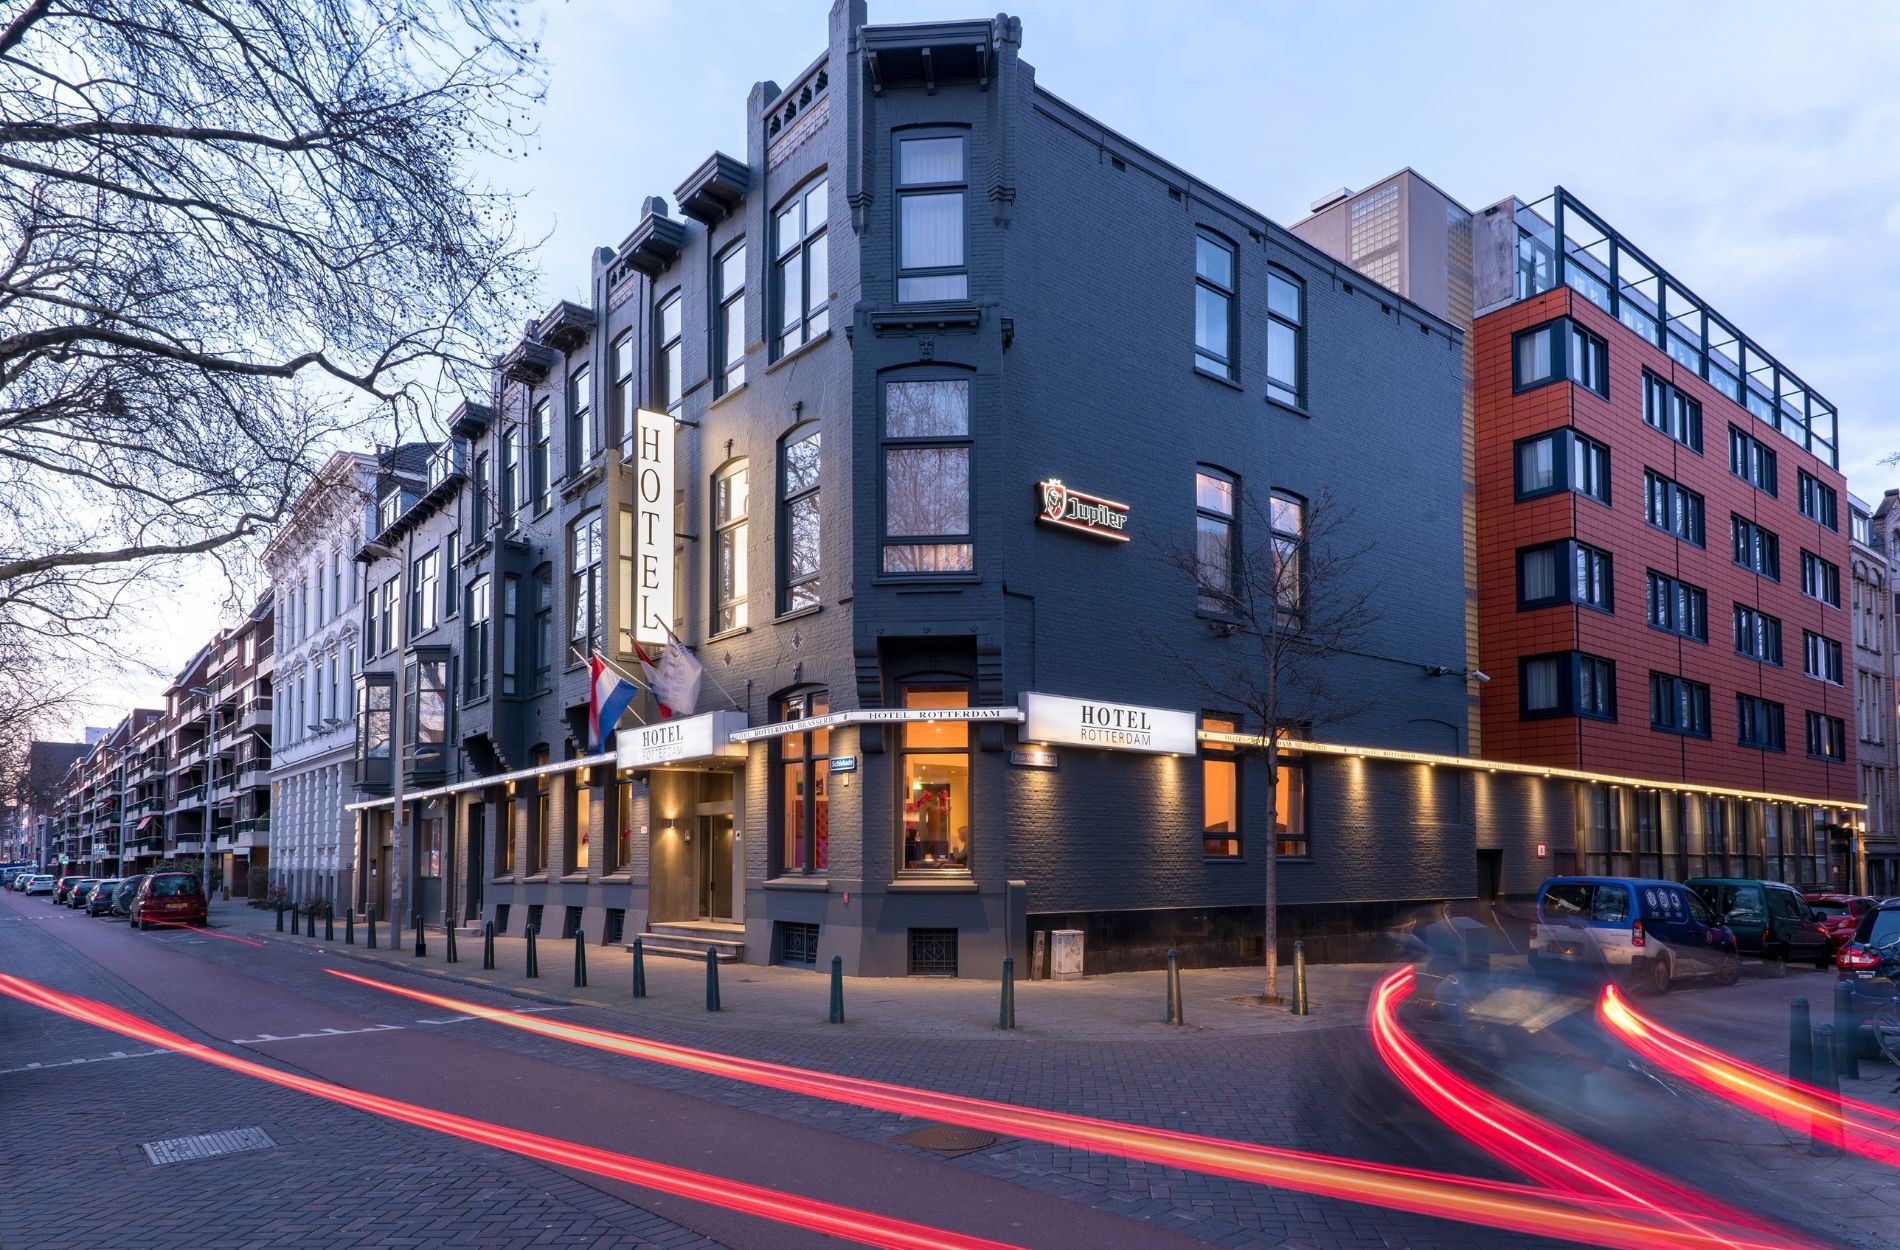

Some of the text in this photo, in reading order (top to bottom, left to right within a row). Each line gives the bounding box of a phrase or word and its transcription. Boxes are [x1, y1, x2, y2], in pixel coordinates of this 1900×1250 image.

[1066, 497, 1128, 530] Jupiler
[640, 426, 661, 630] HOTEL
[869, 710, 1000, 720] HOTEL ROTTERDAM
[1081, 705, 1151, 730] HOTEL
[642, 725, 684, 747] HOTEL
[754, 723, 794, 737] ROTTERDAM
[1081, 728, 1151, 746] ROTTERDAM
